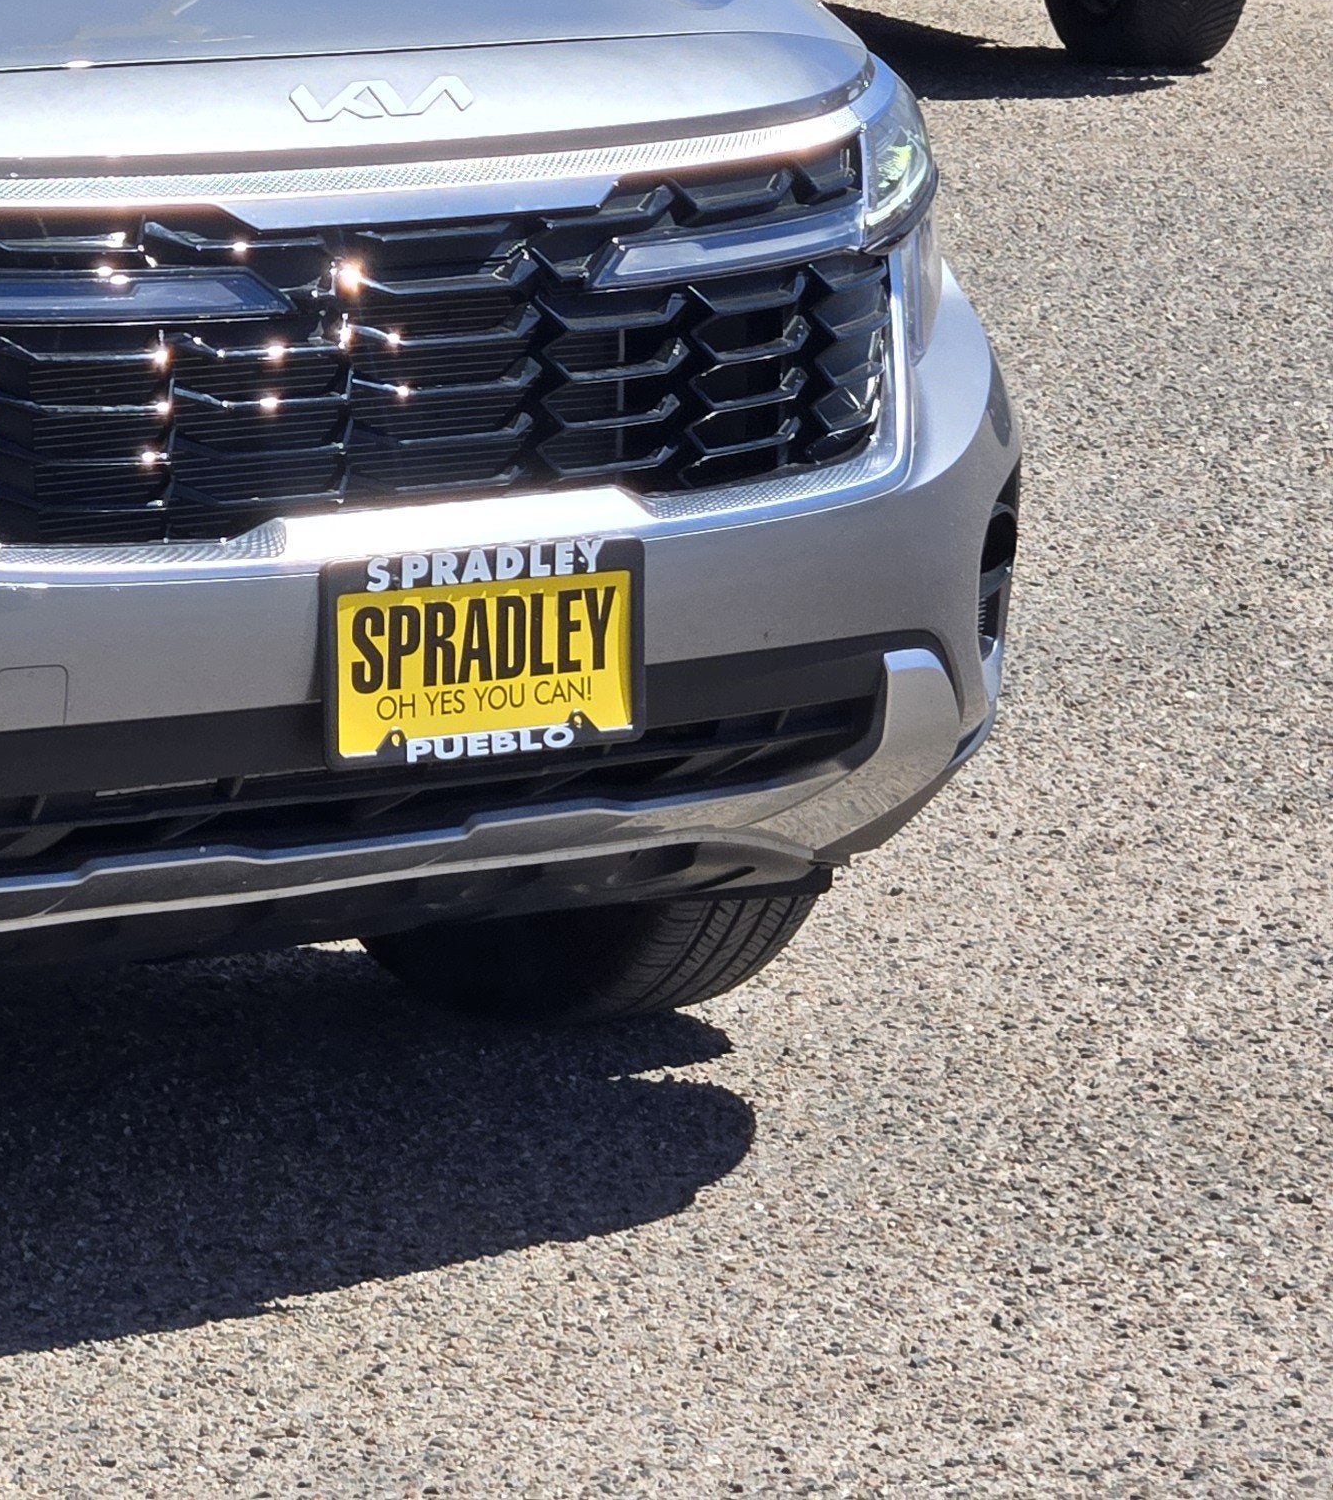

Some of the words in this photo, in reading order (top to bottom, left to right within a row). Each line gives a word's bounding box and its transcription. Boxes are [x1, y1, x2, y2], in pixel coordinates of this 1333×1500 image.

[288, 74, 475, 123] KIA
[366, 538, 605, 592] SPRADLEY
[351, 585, 617, 694] SPRADLEY
[376, 693, 416, 721] OH
[424, 690, 465, 716] YES
[474, 684, 525, 712] YOU
[533, 676, 593, 705] CAN!
[406, 727, 575, 763] PUEBLO
